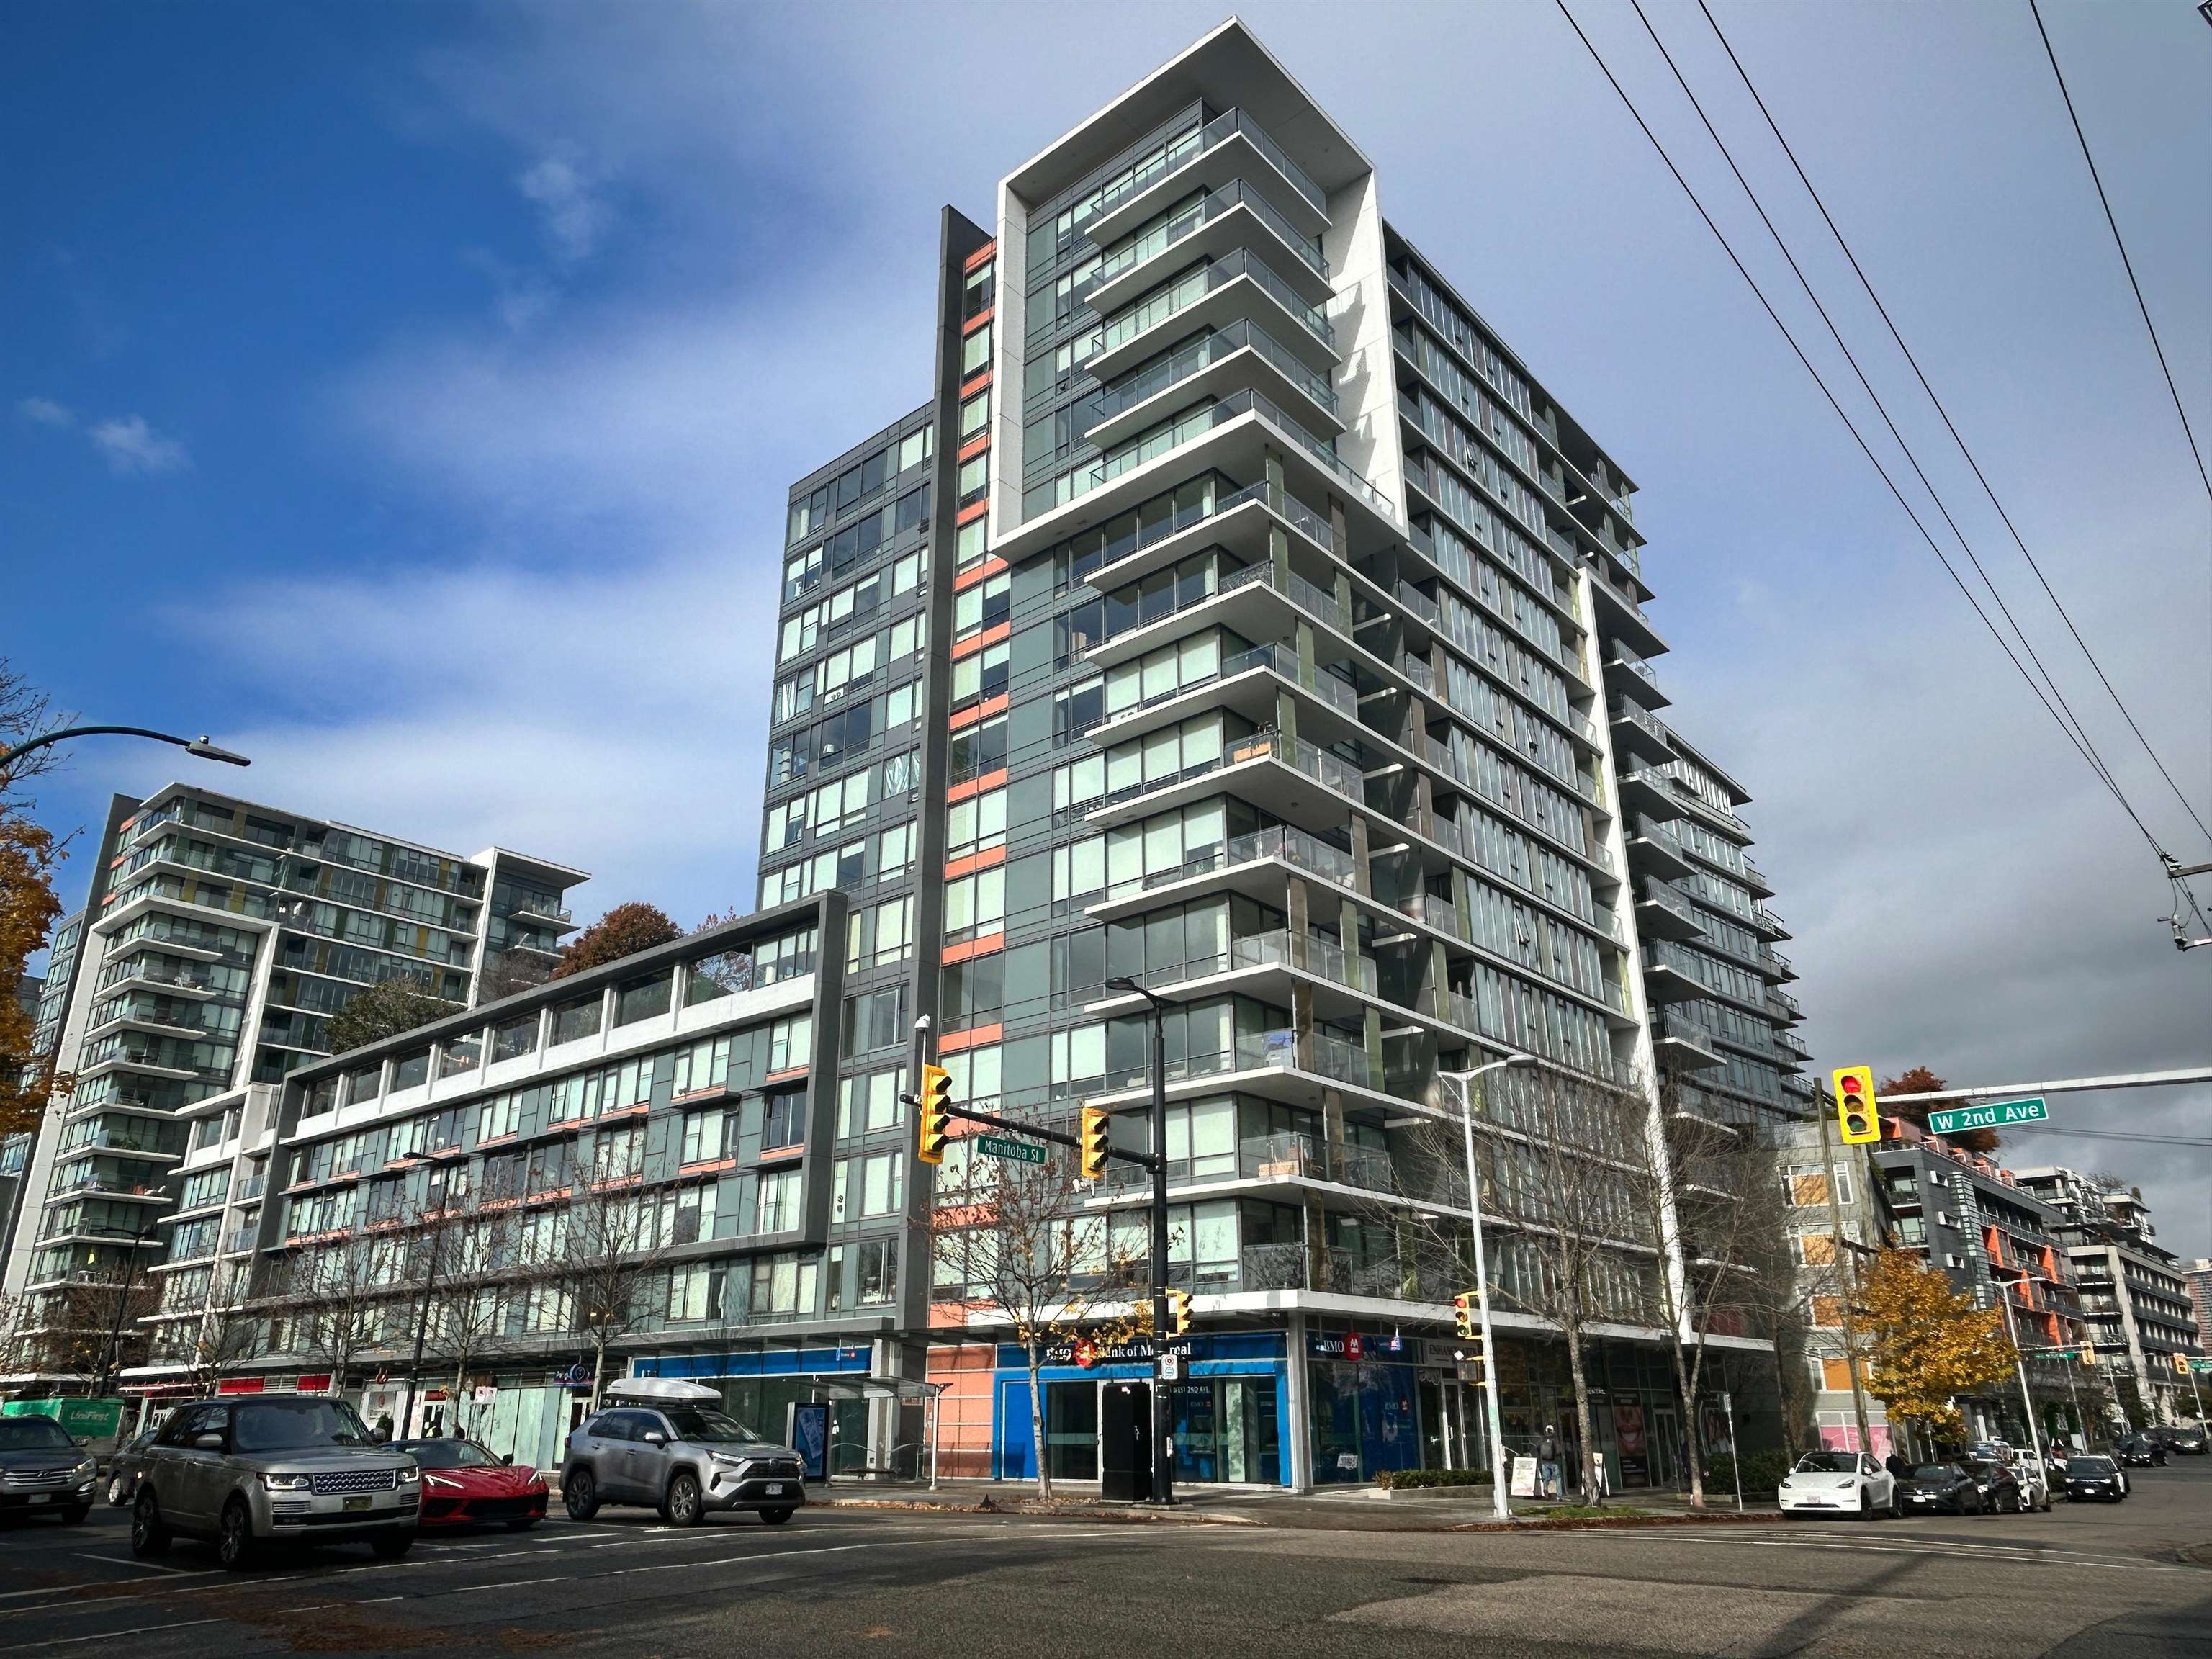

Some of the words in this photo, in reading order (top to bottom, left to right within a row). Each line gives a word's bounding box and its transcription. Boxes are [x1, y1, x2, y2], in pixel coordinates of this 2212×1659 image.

[1936, 1114, 1954, 1130] W
[1961, 1107, 1997, 1126] 2nd
[2005, 1105, 2040, 1121] Ave
[984, 1140, 1028, 1159] Manitoba
[1030, 1148, 1039, 1162] St
[1127, 1345, 1139, 1357] of
[1323, 1341, 1344, 1353] BMO
